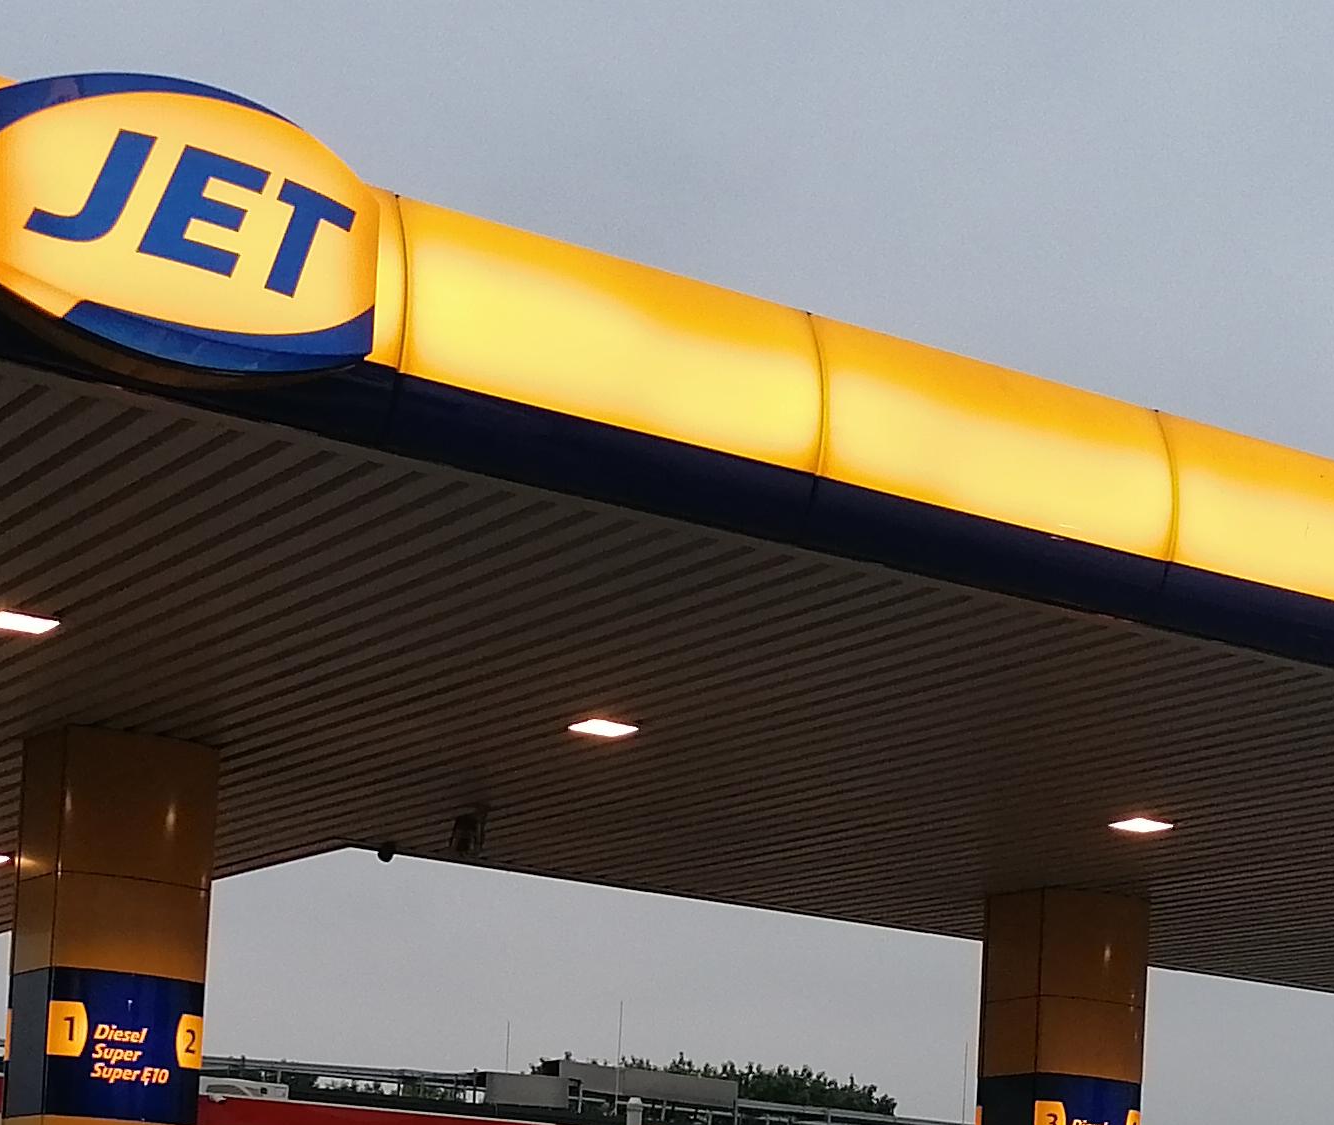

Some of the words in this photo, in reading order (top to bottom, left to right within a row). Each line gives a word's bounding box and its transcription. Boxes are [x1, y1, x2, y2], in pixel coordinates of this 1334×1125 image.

[23, 128, 357, 298] JET
[64, 1016, 76, 1042] 1
[94, 1023, 148, 1044] Diesel
[92, 1043, 143, 1064] Super
[184, 1029, 197, 1054] 2
[90, 1062, 140, 1084] Super
[140, 1067, 170, 1086] E10
